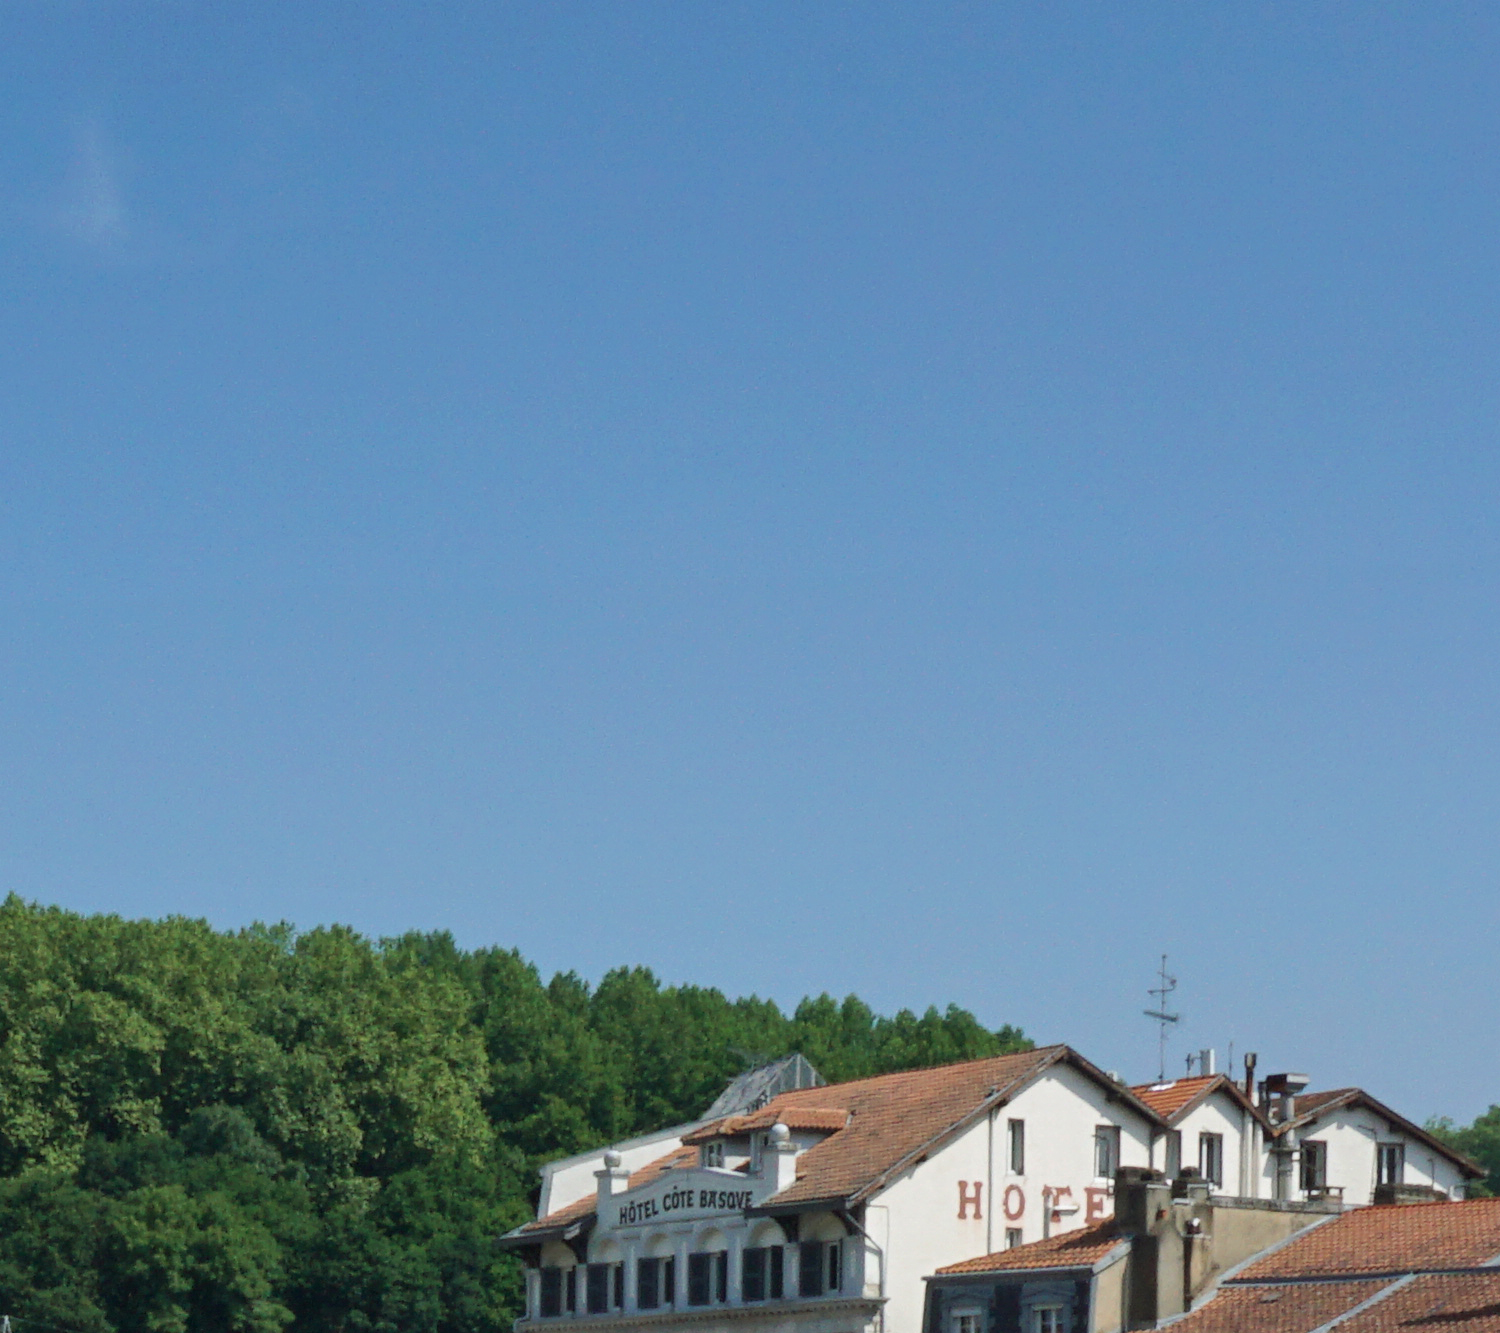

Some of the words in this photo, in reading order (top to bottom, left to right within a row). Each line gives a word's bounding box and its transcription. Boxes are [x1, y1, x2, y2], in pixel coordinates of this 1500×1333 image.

[619, 1199, 659, 1224] HÔTEL
[663, 1186, 694, 1211] CÔTE
[957, 1180, 1114, 1224] HOTE
